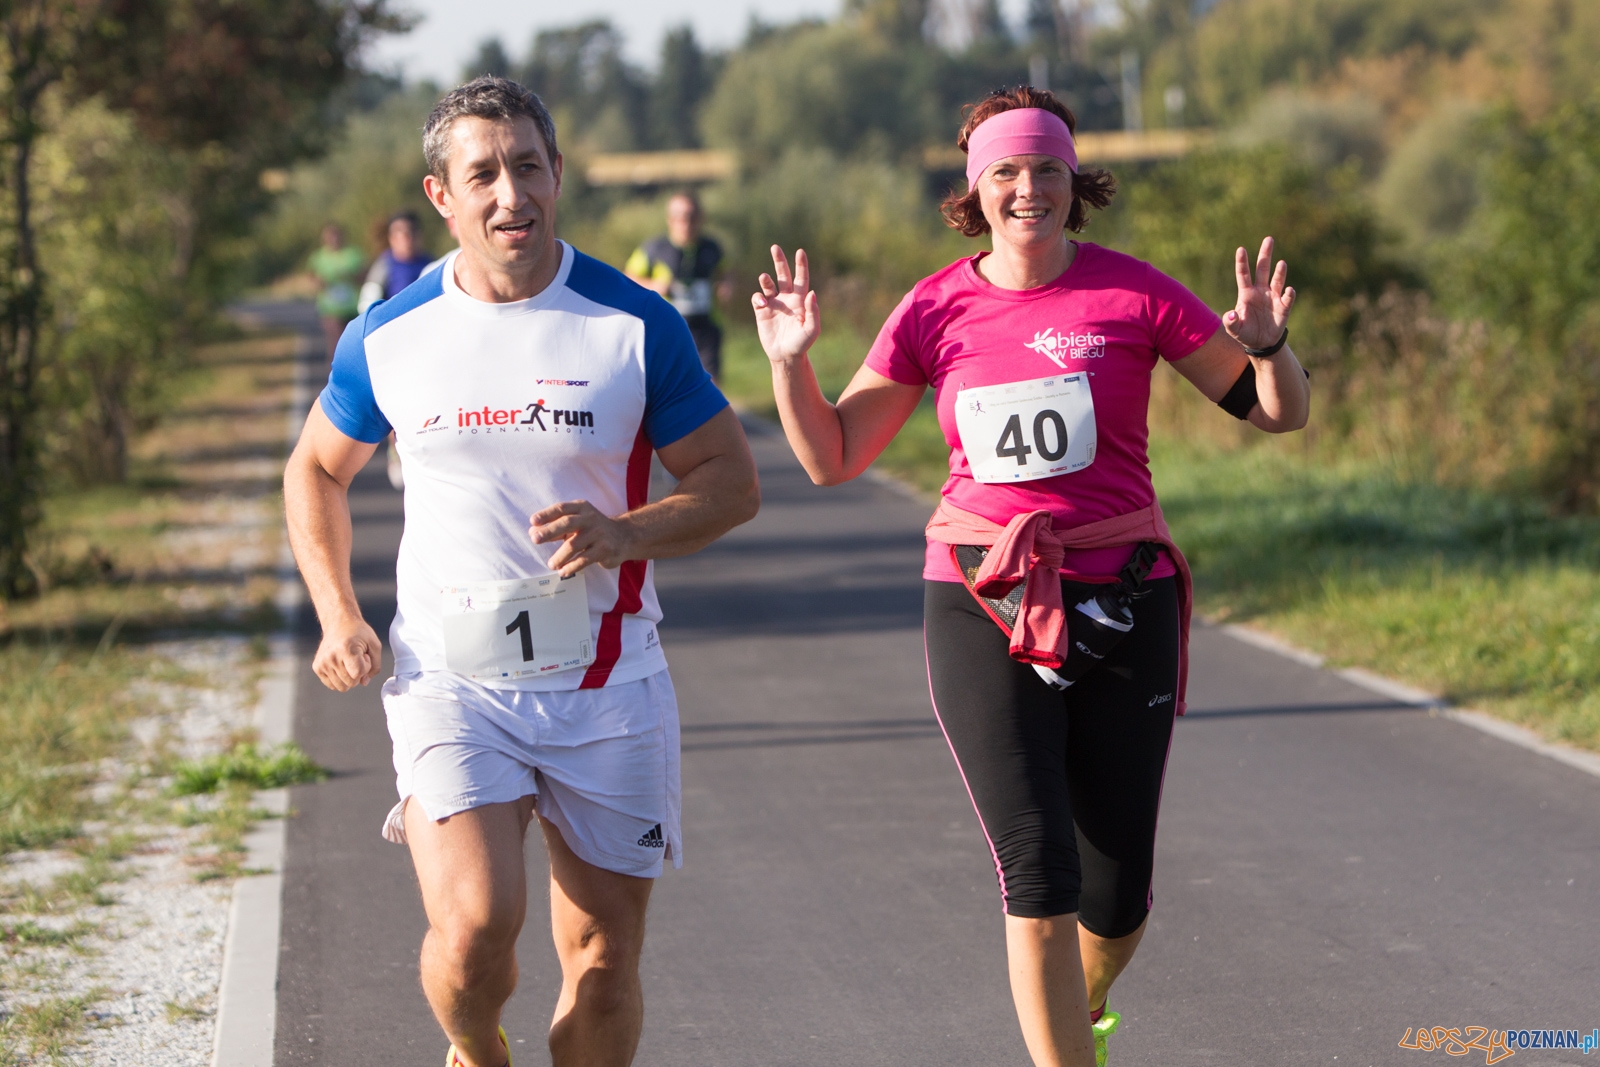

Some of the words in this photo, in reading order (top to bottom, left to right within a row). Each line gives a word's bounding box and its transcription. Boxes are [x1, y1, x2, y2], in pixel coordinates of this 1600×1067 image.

[1070, 346, 1105, 359] BIEGU
[544, 379, 590, 387] INTERSPORT
[458, 406, 522, 428] inter
[553, 409, 594, 428] run
[554, 427, 595, 436] 2014
[995, 409, 1069, 467] 40
[505, 610, 534, 662] 1
[637, 838, 665, 848] adidas
